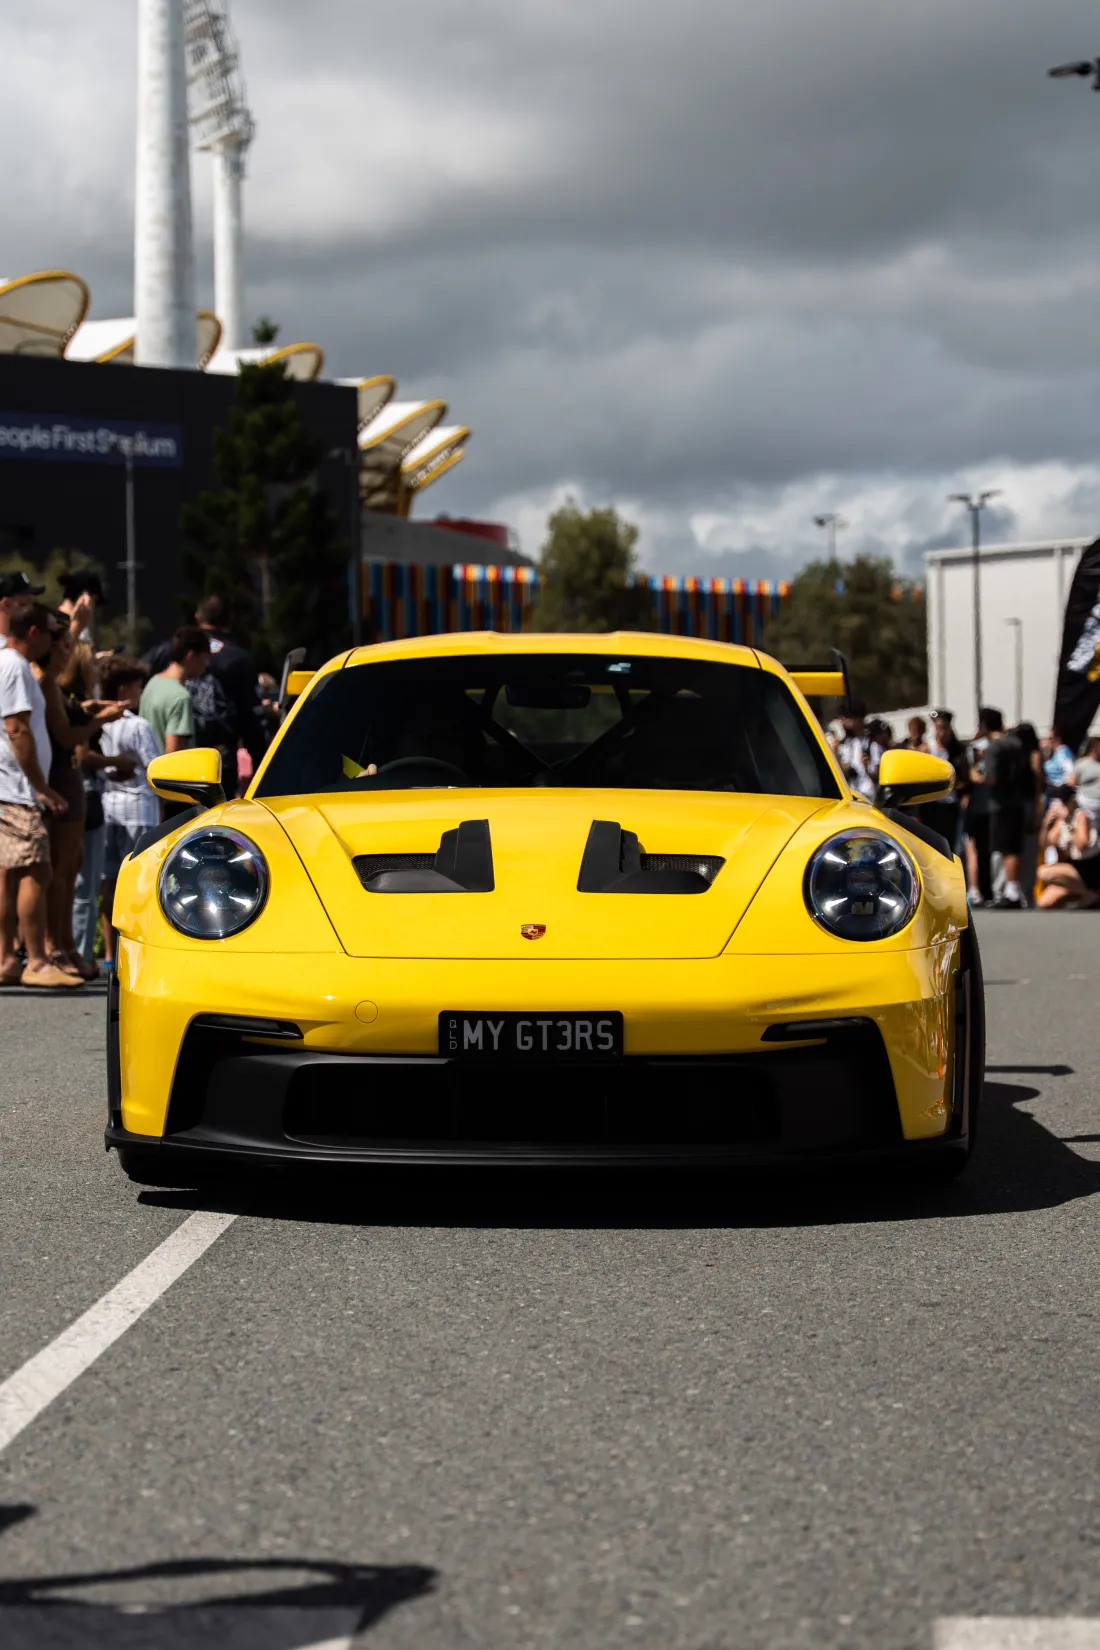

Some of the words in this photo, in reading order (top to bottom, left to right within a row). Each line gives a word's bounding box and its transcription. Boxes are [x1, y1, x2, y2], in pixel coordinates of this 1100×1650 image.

[96, 427, 177, 458] Sdium
[449, 1020, 458, 1050] QLD
[463, 1020, 505, 1050] MY
[516, 1020, 614, 1050] GT3RS
